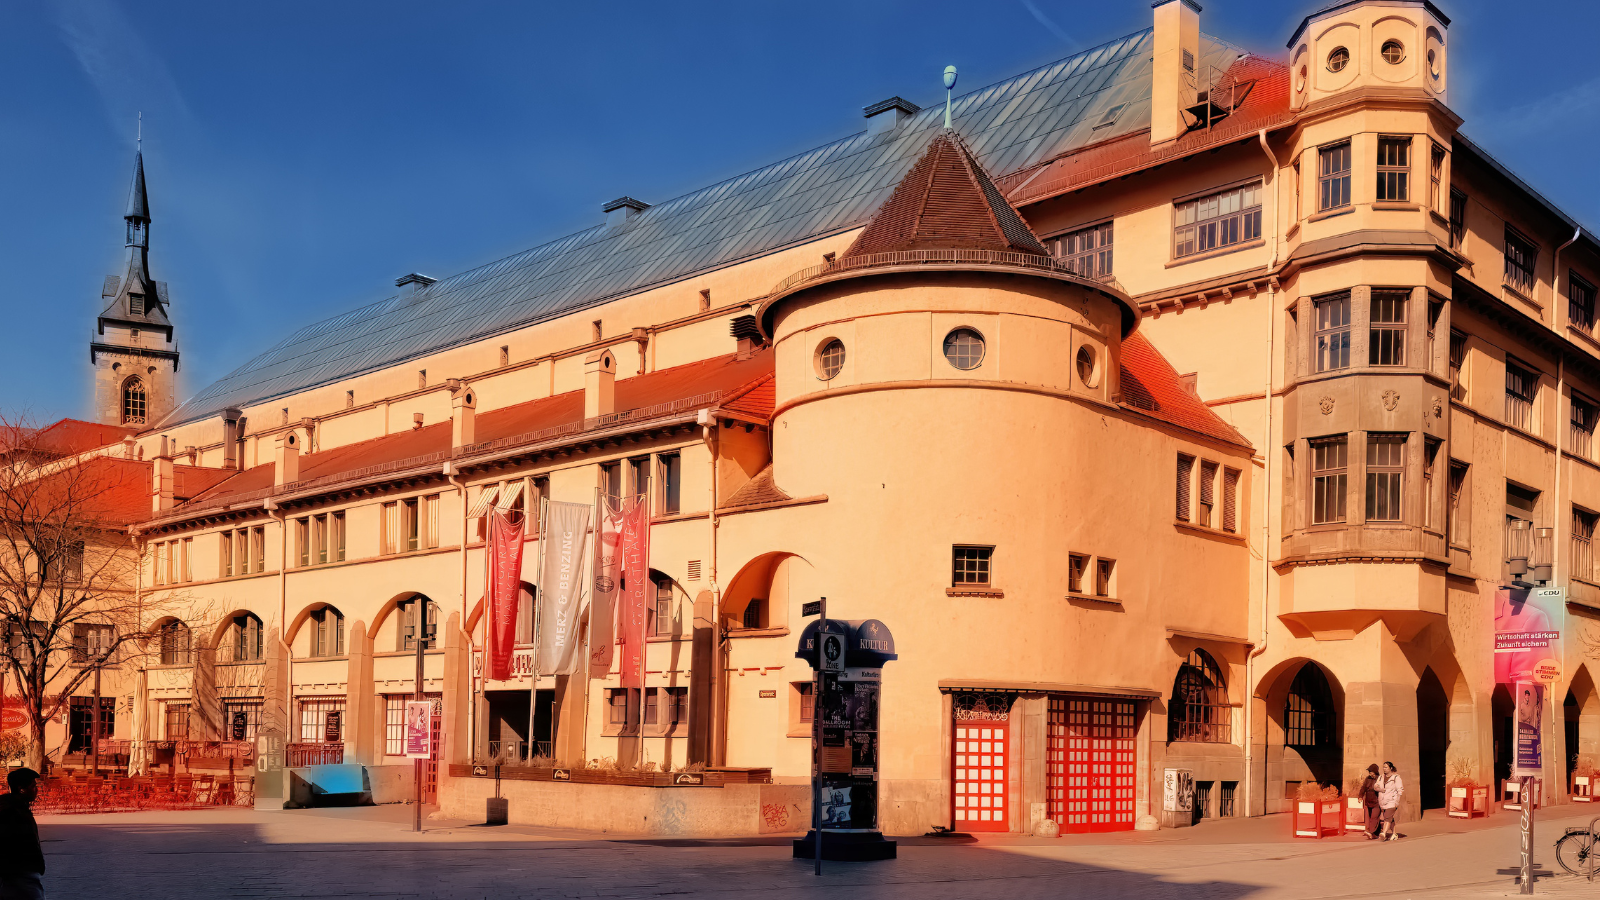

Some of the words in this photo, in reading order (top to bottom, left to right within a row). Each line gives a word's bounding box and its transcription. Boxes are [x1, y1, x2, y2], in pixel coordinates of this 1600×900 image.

[559, 531, 573, 590] BENZING
[558, 594, 567, 605] &
[555, 610, 567, 647] MERZ
[860, 638, 888, 651] KULTUR
